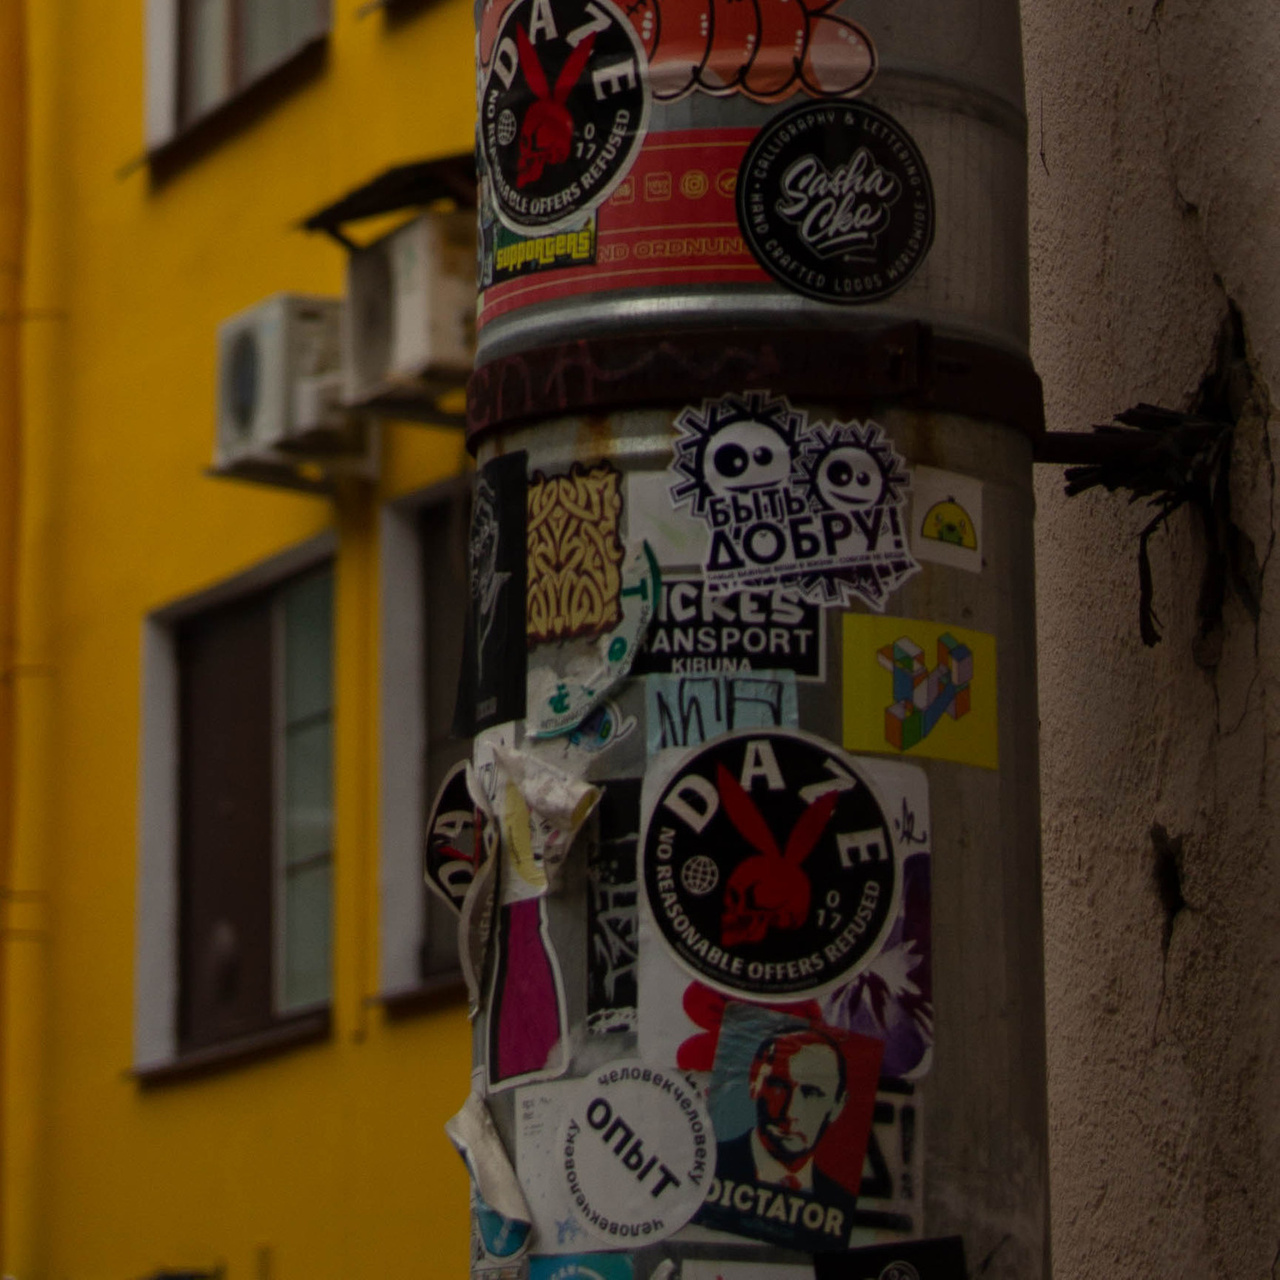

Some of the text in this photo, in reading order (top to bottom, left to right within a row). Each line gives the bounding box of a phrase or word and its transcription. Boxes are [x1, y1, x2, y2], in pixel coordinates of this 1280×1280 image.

[529, 186, 582, 215] OFFERS
[580, 108, 631, 189] REFUSED
[753, 111, 837, 180] CALLIGRAPHY
[863, 116, 922, 186] LETTERING
[778, 150, 896, 217] Sasha
[596, 236, 749, 263] ND ORDNUN
[750, 192, 771, 236] HAND
[764, 237, 827, 289] CRAFTED
[833, 272, 884, 294] LOGOS
[709, 487, 806, 527] БЫТЬ
[706, 506, 904, 571] ДОБРУ!
[658, 582, 806, 625] ICKES
[644, 627, 814, 654] ANSPORT
[671, 656, 753, 674] KIRUNA
[655, 825, 677, 859] NO
[655, 864, 746, 976] REASONABLE
[824, 880, 881, 964] REFUSED
[747, 955, 825, 981] OFFERS
[704, 1177, 845, 1236] DICTATOR
